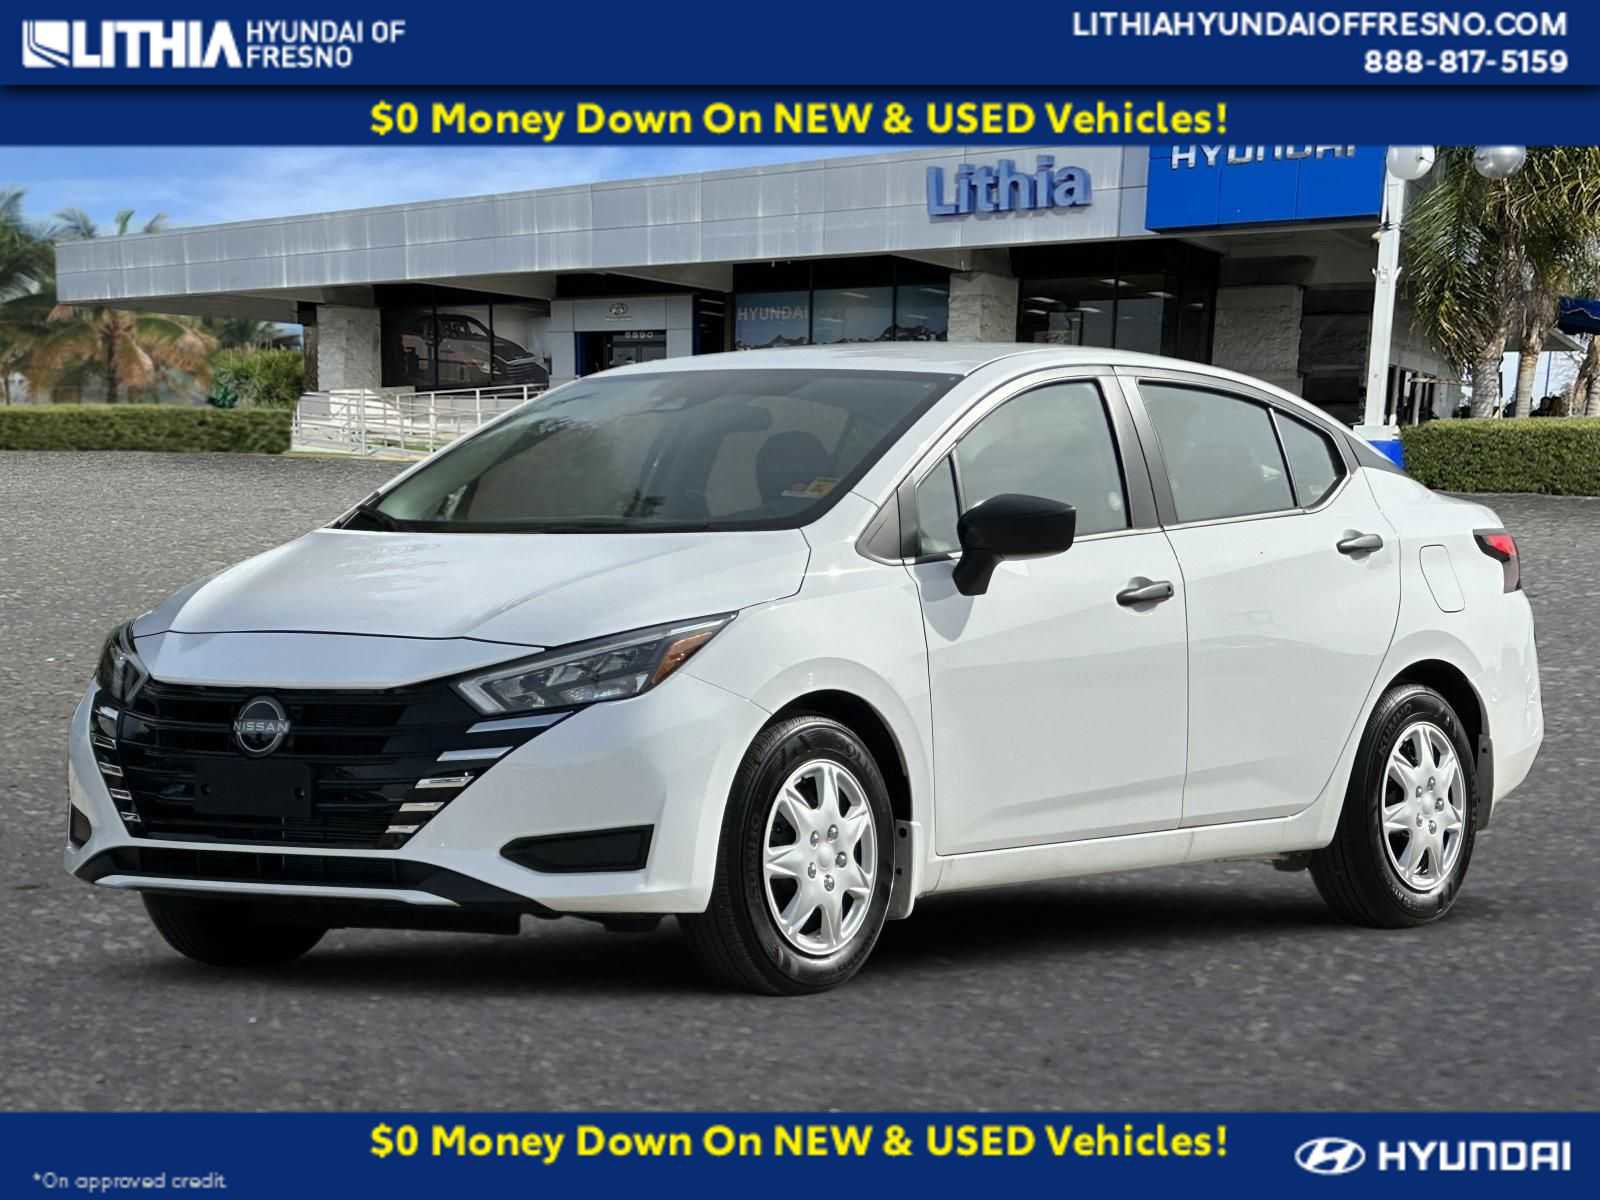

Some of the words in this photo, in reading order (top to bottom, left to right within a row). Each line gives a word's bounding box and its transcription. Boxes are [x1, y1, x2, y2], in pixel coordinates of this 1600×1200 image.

[927, 154, 1092, 216] Lithia
[736, 304, 809, 321] HYUNDAI
[232, 720, 291, 733] NISSAN
